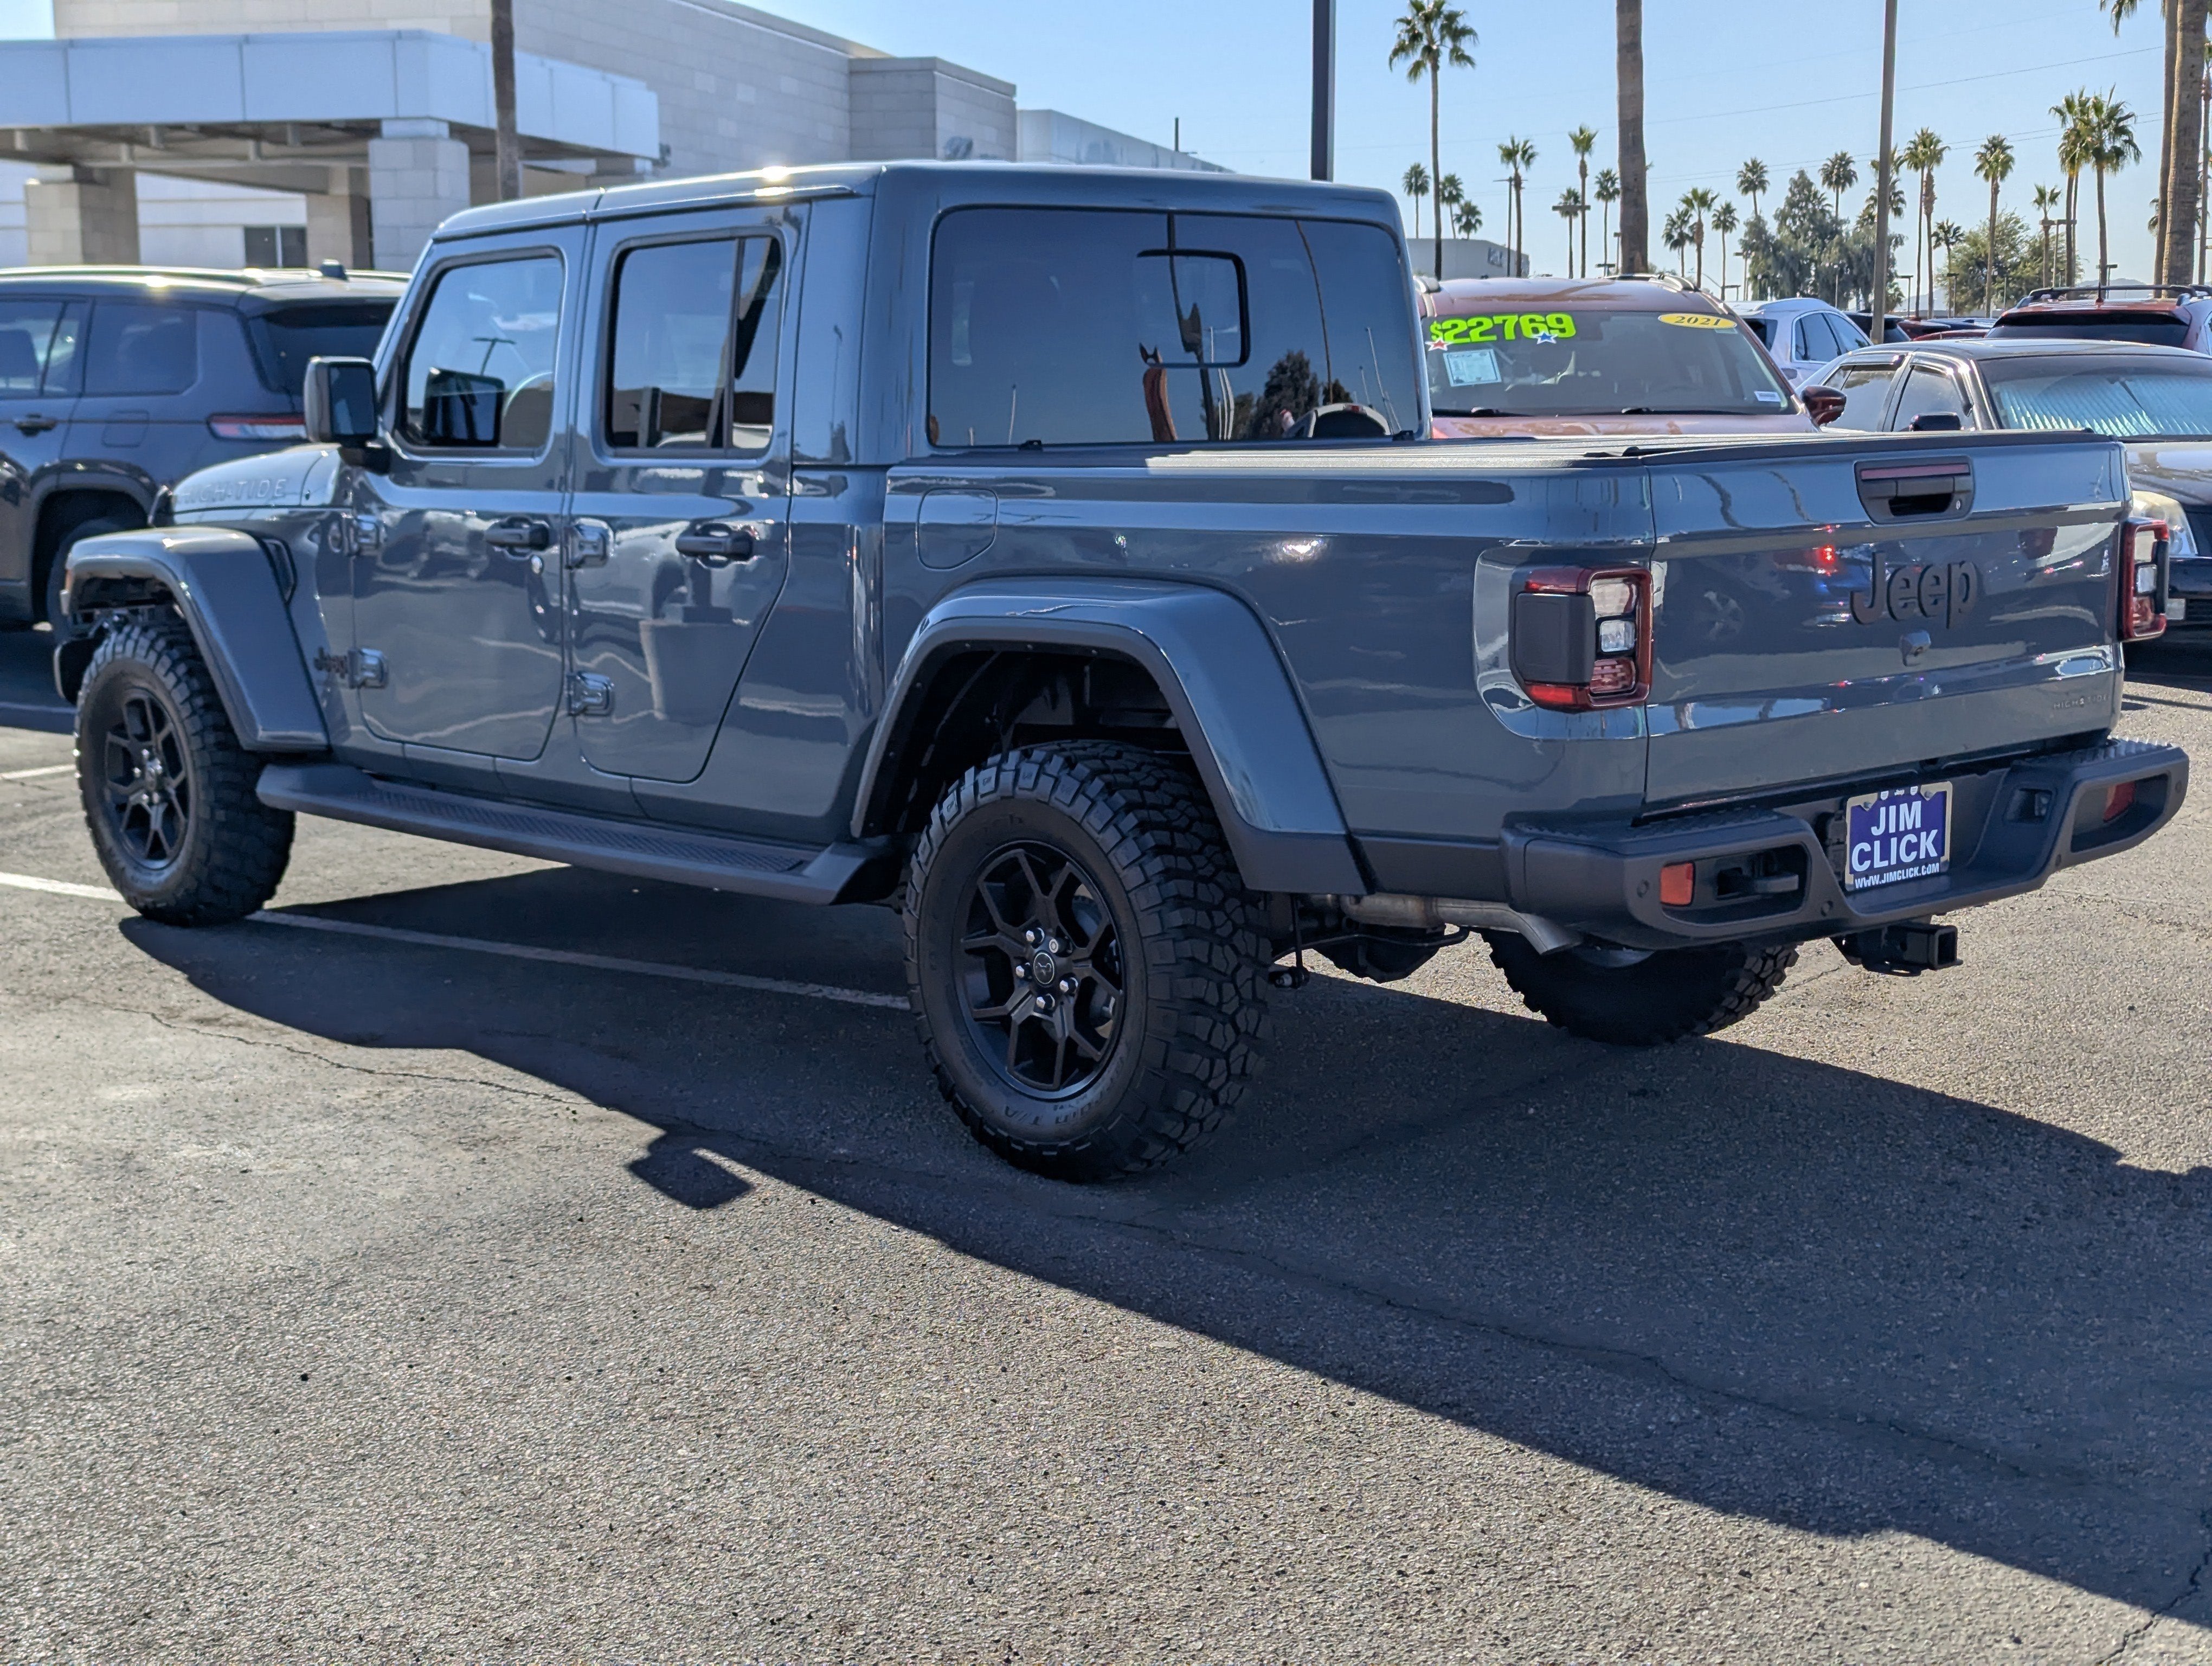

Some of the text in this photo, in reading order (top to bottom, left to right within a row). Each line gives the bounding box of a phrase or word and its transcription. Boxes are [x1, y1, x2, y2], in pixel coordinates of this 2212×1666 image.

[1430, 313, 1577, 344] $22769
[1674, 316, 1721, 326] 2021
[235, 478, 287, 501] TIDE
[1850, 550, 1979, 629] Jeep
[1870, 800, 1922, 836] JIM
[1851, 829, 1939, 872] CLICK
[1855, 862, 1940, 889] WWW.JIMCLICK.COM
